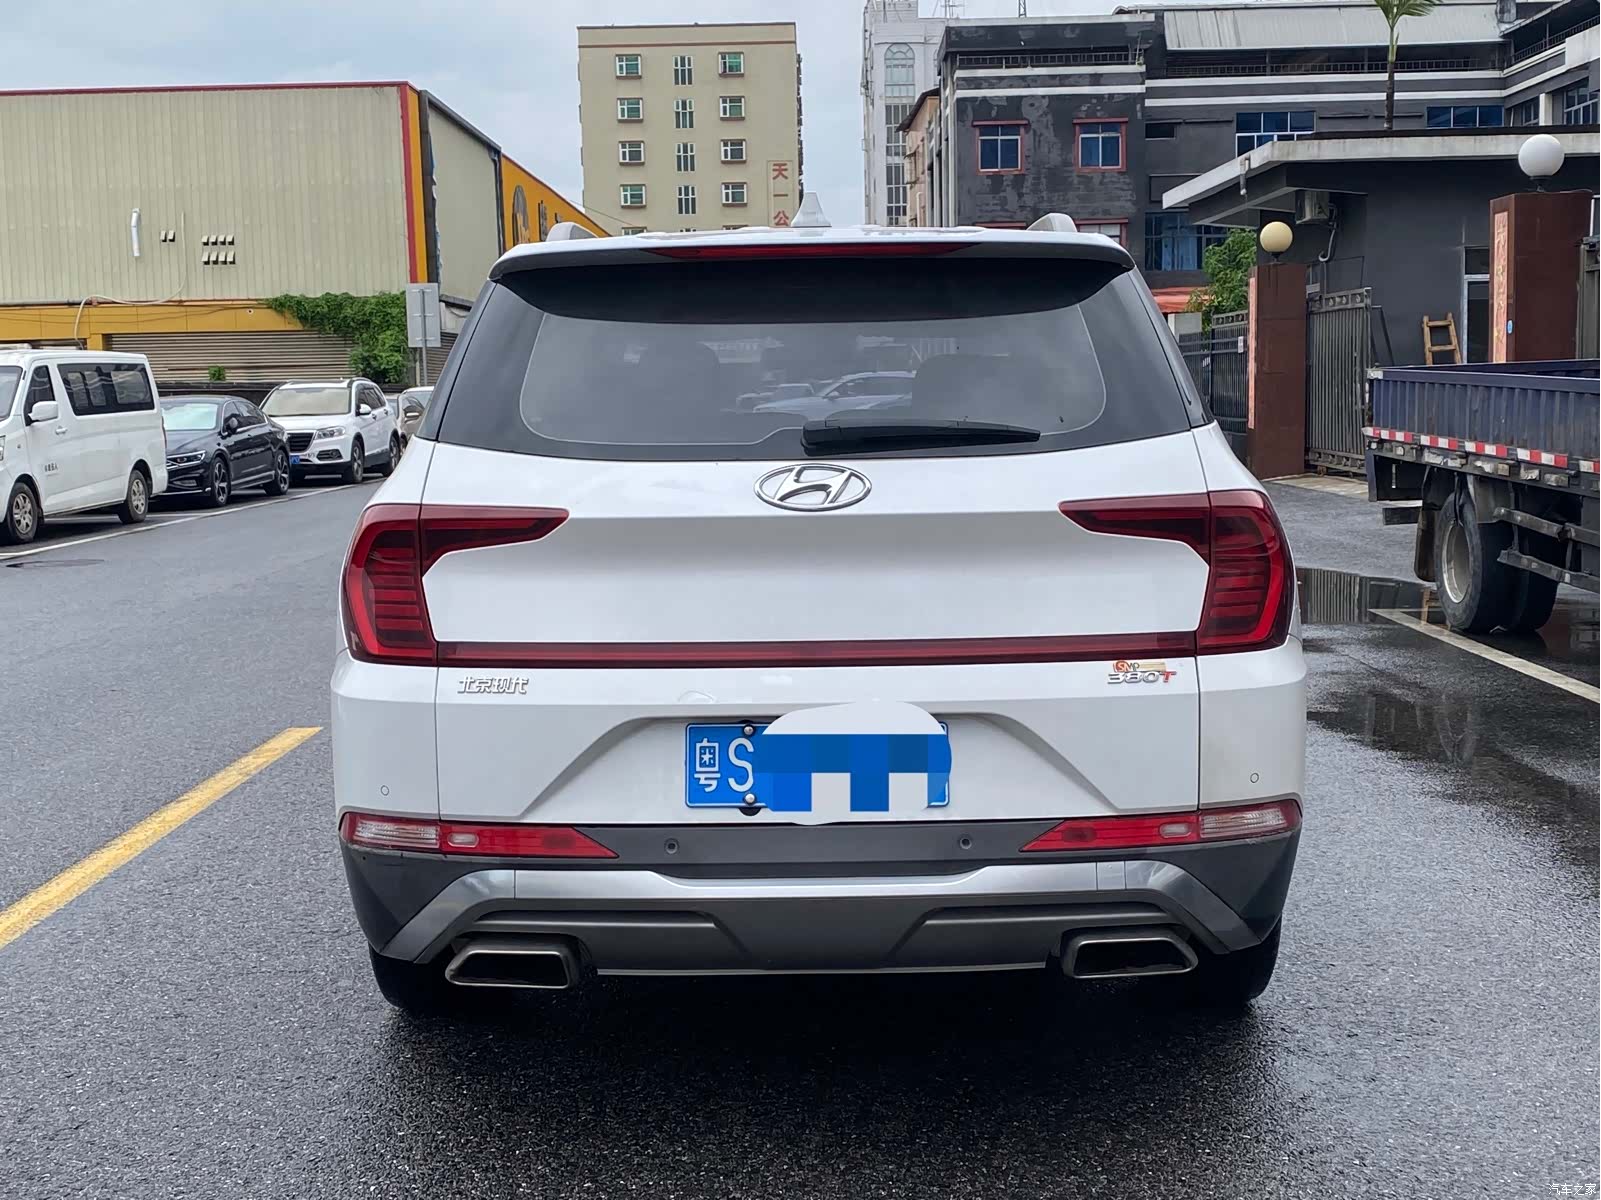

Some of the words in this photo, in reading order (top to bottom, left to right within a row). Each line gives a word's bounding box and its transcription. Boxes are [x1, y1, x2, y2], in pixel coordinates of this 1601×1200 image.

[1108, 671, 1177, 684] 380T
[458, 677, 528, 694] 北京现代
